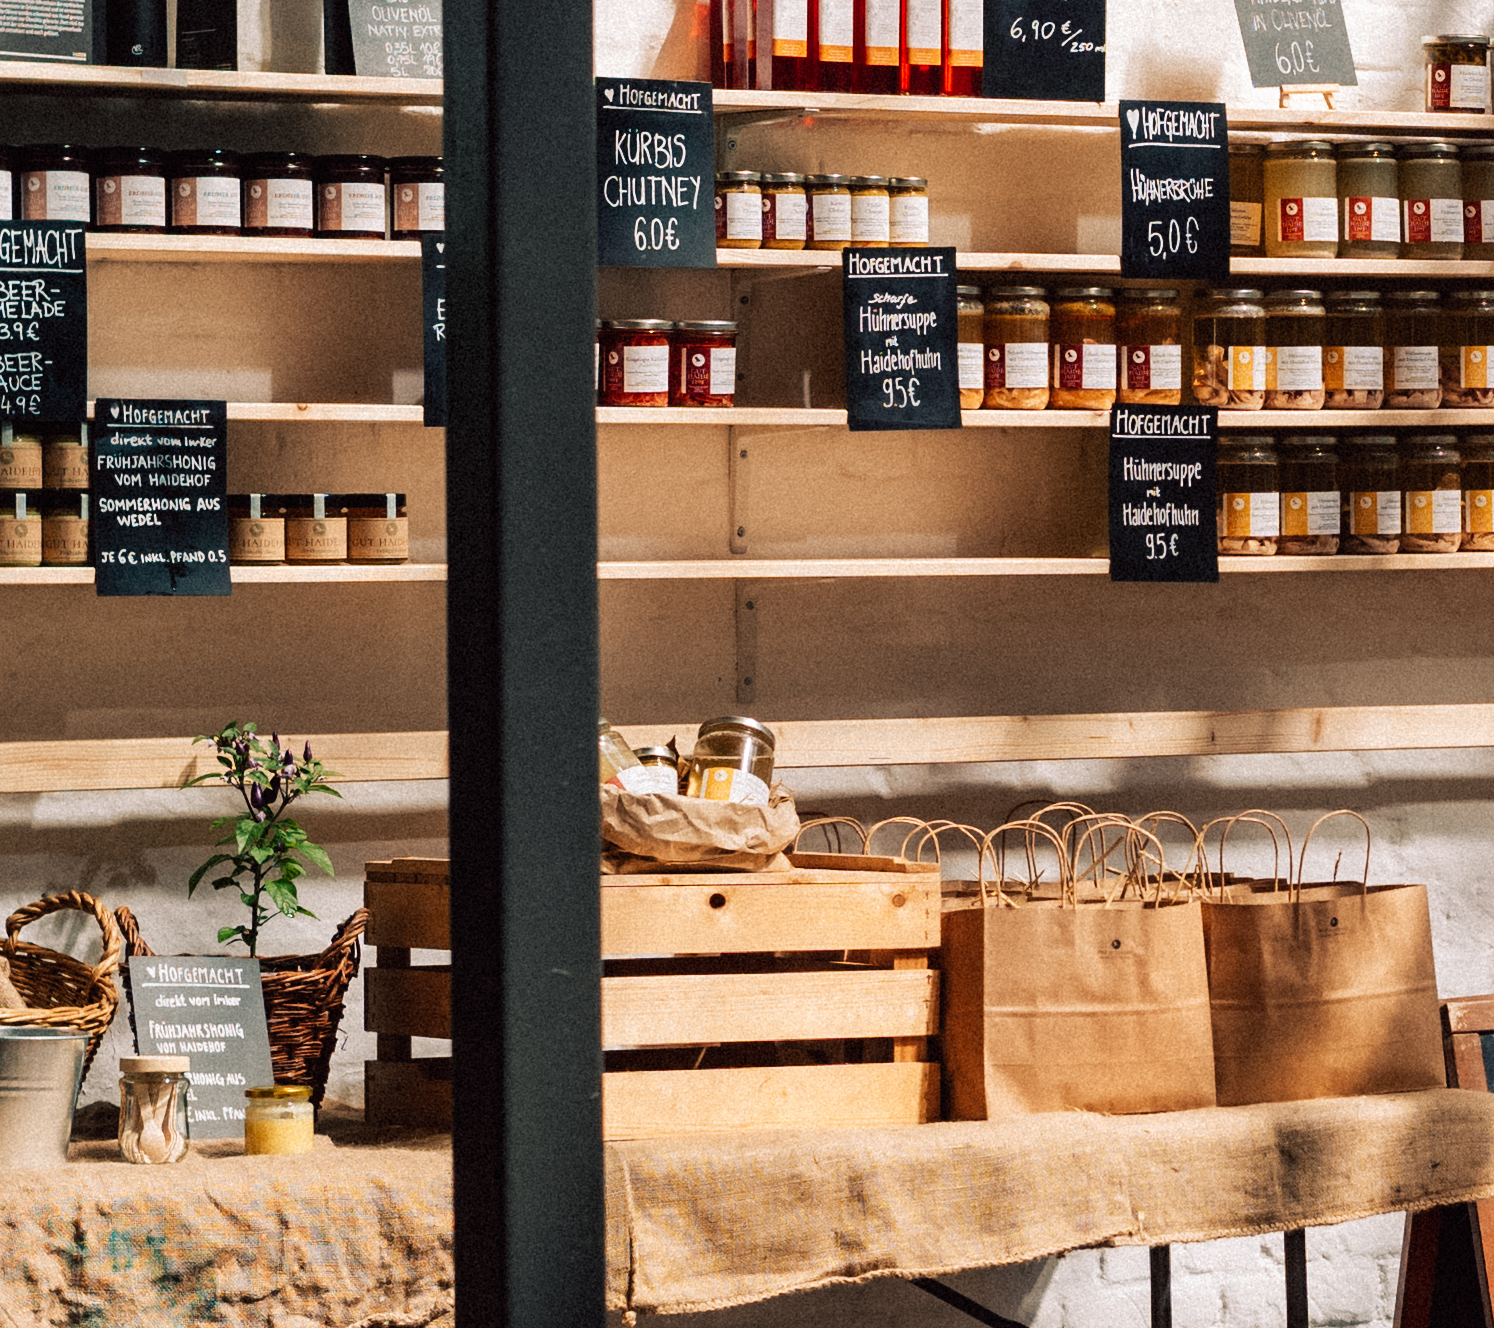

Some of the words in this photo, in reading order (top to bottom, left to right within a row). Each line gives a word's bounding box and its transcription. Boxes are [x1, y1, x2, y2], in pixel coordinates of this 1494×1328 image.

[372, 4, 437, 22] OLIVENÖL
[367, 24, 407, 38] NATIV
[413, 25, 442, 38] EXTR
[620, 84, 701, 110] HOFGEMACHT
[1142, 106, 1220, 142] HOFGEMACHT
[616, 128, 686, 169] KÜRBIS
[604, 175, 700, 210] CHUTNEY
[634, 217, 680, 250] 6.0€
[849, 253, 943, 274] HOFGEMACHT
[860, 305, 937, 335] Hühnersuppe
[885, 335, 898, 347] mit
[861, 347, 941, 374] Haidehofhuhn
[123, 404, 210, 424] HOFGEMACHT
[1117, 409, 1210, 435] HOFGEMACHT
[111, 432, 153, 446] direkt
[157, 438, 181, 446] vom
[97, 453, 216, 470] FRÜHJAHRSHONIG
[115, 474, 142, 487] VOM
[149, 473, 211, 487] HAIDEHOF
[1124, 457, 1201, 487] Hühnersuppe
[99, 497, 191, 512] SOMMERHONIG
[197, 498, 220, 510] AUS
[117, 514, 161, 527] WEDEL
[1123, 502, 1199, 527] Haidehofhuhn
[101, 551, 115, 563] JE
[170, 551, 206, 563] PFAND
[158, 963, 243, 984] HOFGEMACHT
[155, 994, 187, 1007] direkt
[189, 997, 210, 1006] vom
[213, 994, 241, 1006] Imker
[149, 1020, 244, 1039] FRÜHJAHRSHONIG
[157, 1042, 177, 1054] VOM
[180, 1041, 226, 1053] HAIDEHOF
[184, 1073, 225, 1086] RHONIG
[227, 1073, 246, 1085] AUS
[223, 1107, 246, 1120] PFAN
